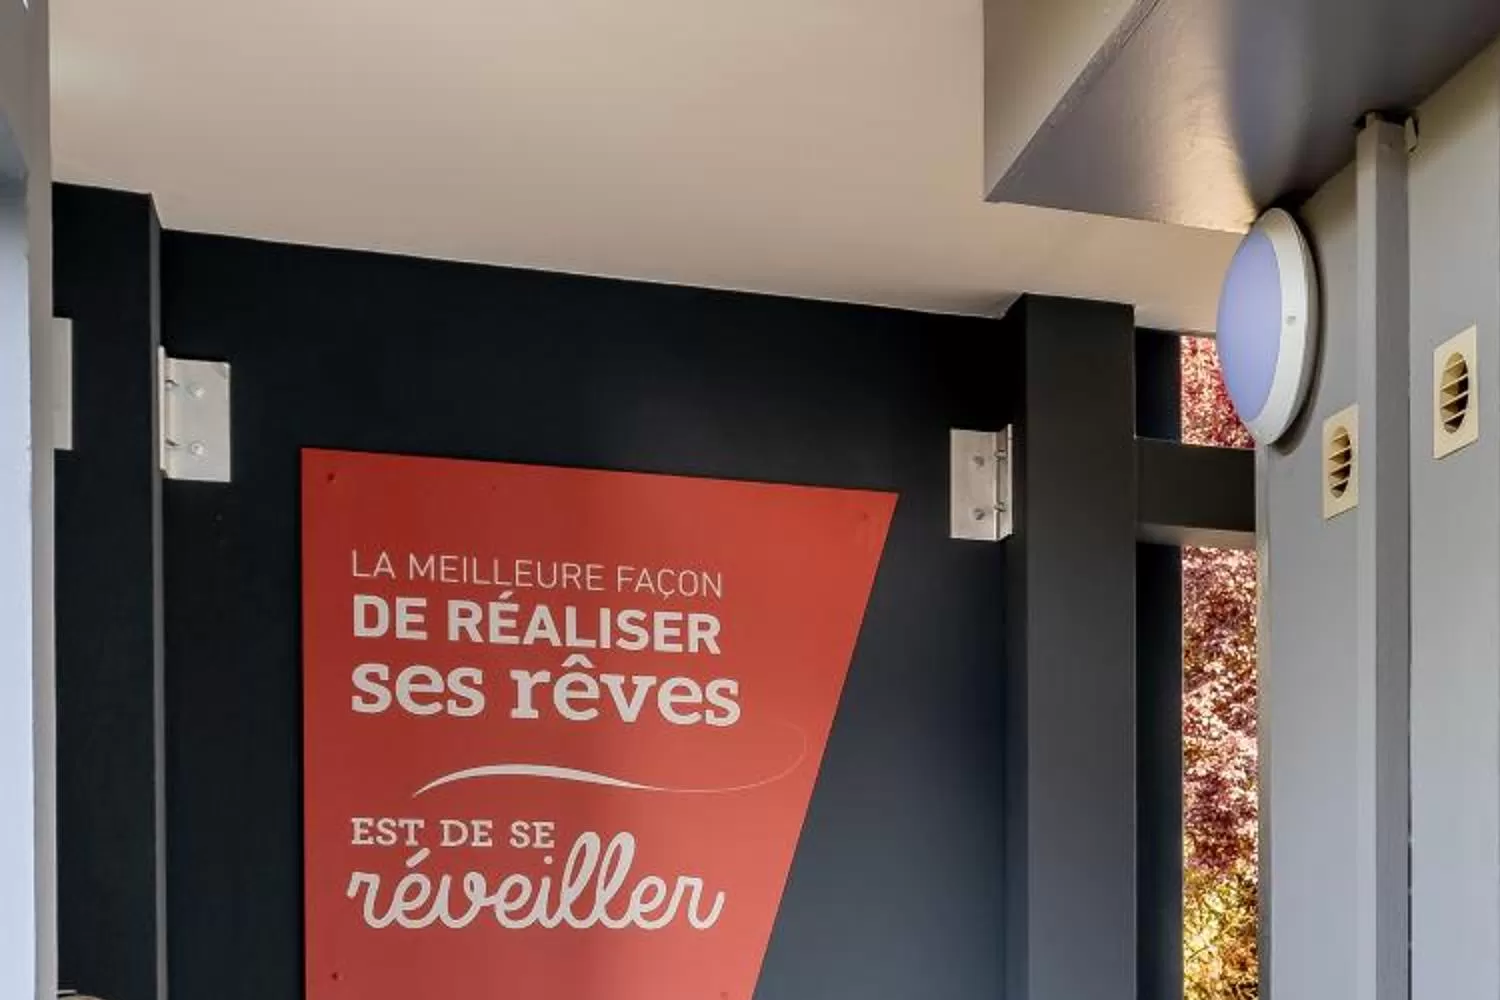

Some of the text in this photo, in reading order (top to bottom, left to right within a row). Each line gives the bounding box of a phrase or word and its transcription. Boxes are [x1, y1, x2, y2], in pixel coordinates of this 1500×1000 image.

[351, 549, 723, 600] LA MEILLEURE FAÇON
[353, 591, 722, 655] DE RÉALISER
[351, 653, 742, 727] ses rêves
[350, 817, 556, 849] EST DE SE
[346, 831, 726, 930] réveiller
